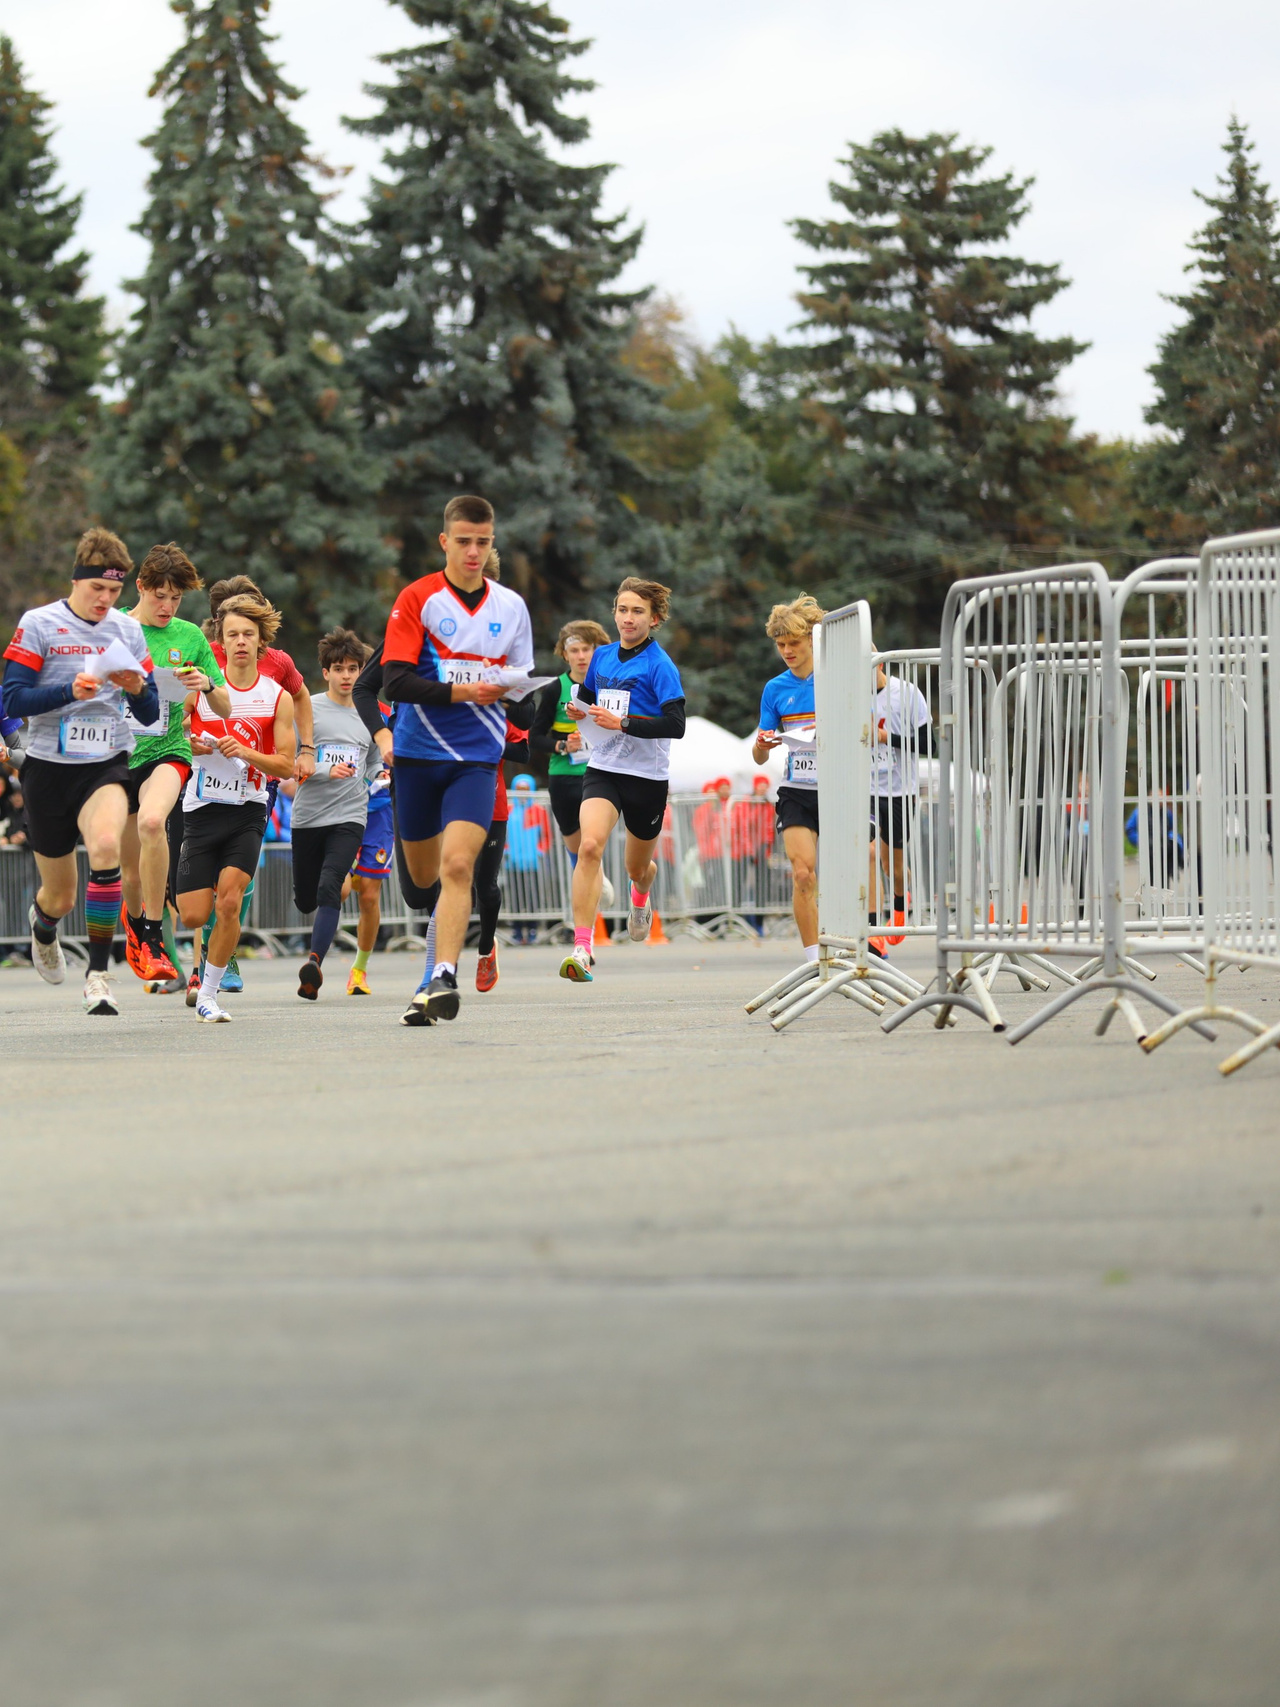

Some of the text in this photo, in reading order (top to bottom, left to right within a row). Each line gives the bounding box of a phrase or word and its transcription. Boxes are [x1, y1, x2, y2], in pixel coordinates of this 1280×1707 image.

[50, 645, 92, 655] NORD
[599, 699, 619, 710] 01.1
[70, 727, 108, 742] 210.1
[233, 721, 251, 740] Run
[794, 760, 817, 770] 202.
